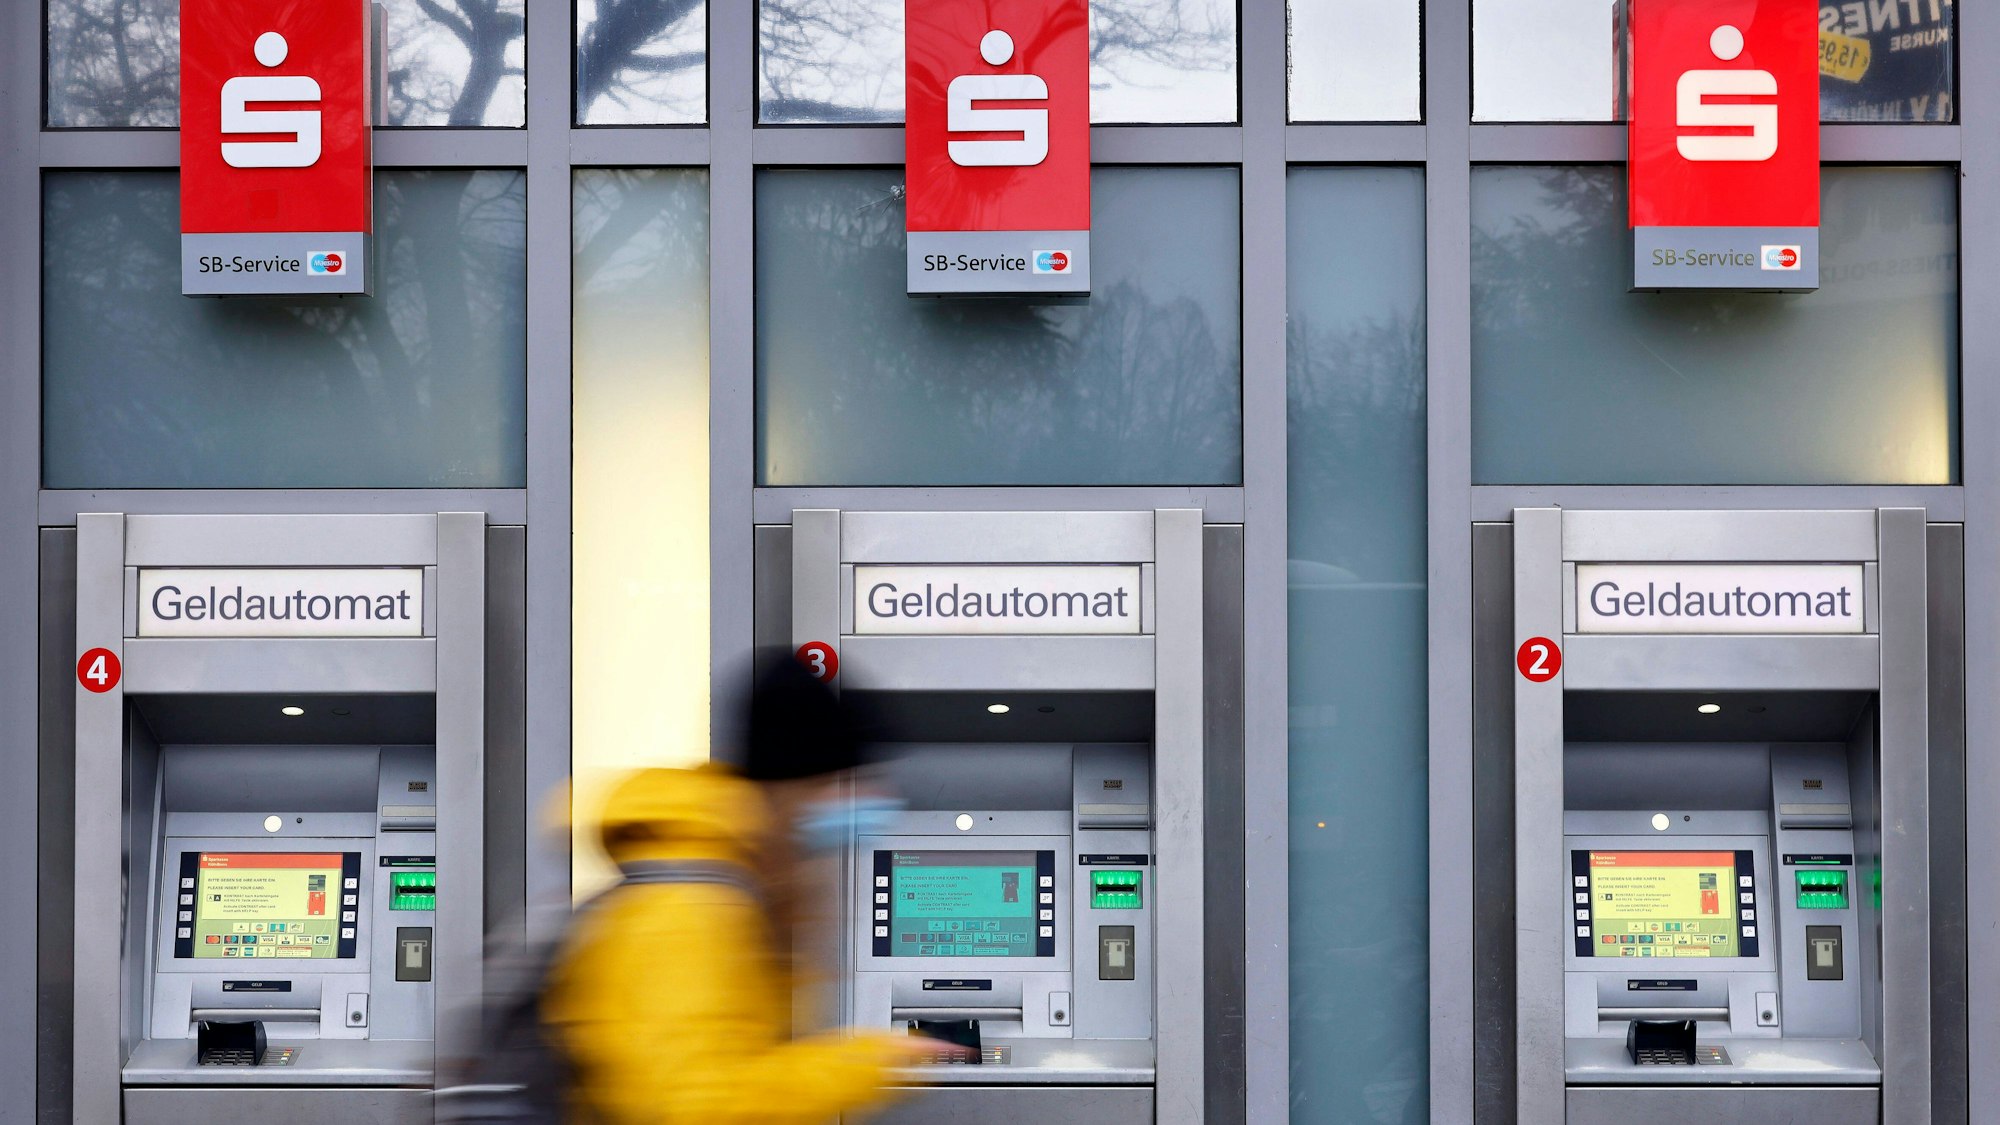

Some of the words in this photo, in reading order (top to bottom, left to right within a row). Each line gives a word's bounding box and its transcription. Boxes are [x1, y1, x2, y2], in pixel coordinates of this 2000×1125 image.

[199, 255, 300, 273] SB-Service
[313, 259, 339, 267] Maestro
[924, 254, 1026, 272] SB-Service
[1652, 248, 1755, 267] SB-Service
[151, 585, 411, 621] Geldautomat
[868, 582, 1129, 618] Geldautomat
[1590, 581, 1852, 617] Geldautomat
[86, 655, 109, 685] 4
[807, 648, 826, 678] 3
[1529, 644, 1550, 675] 2
